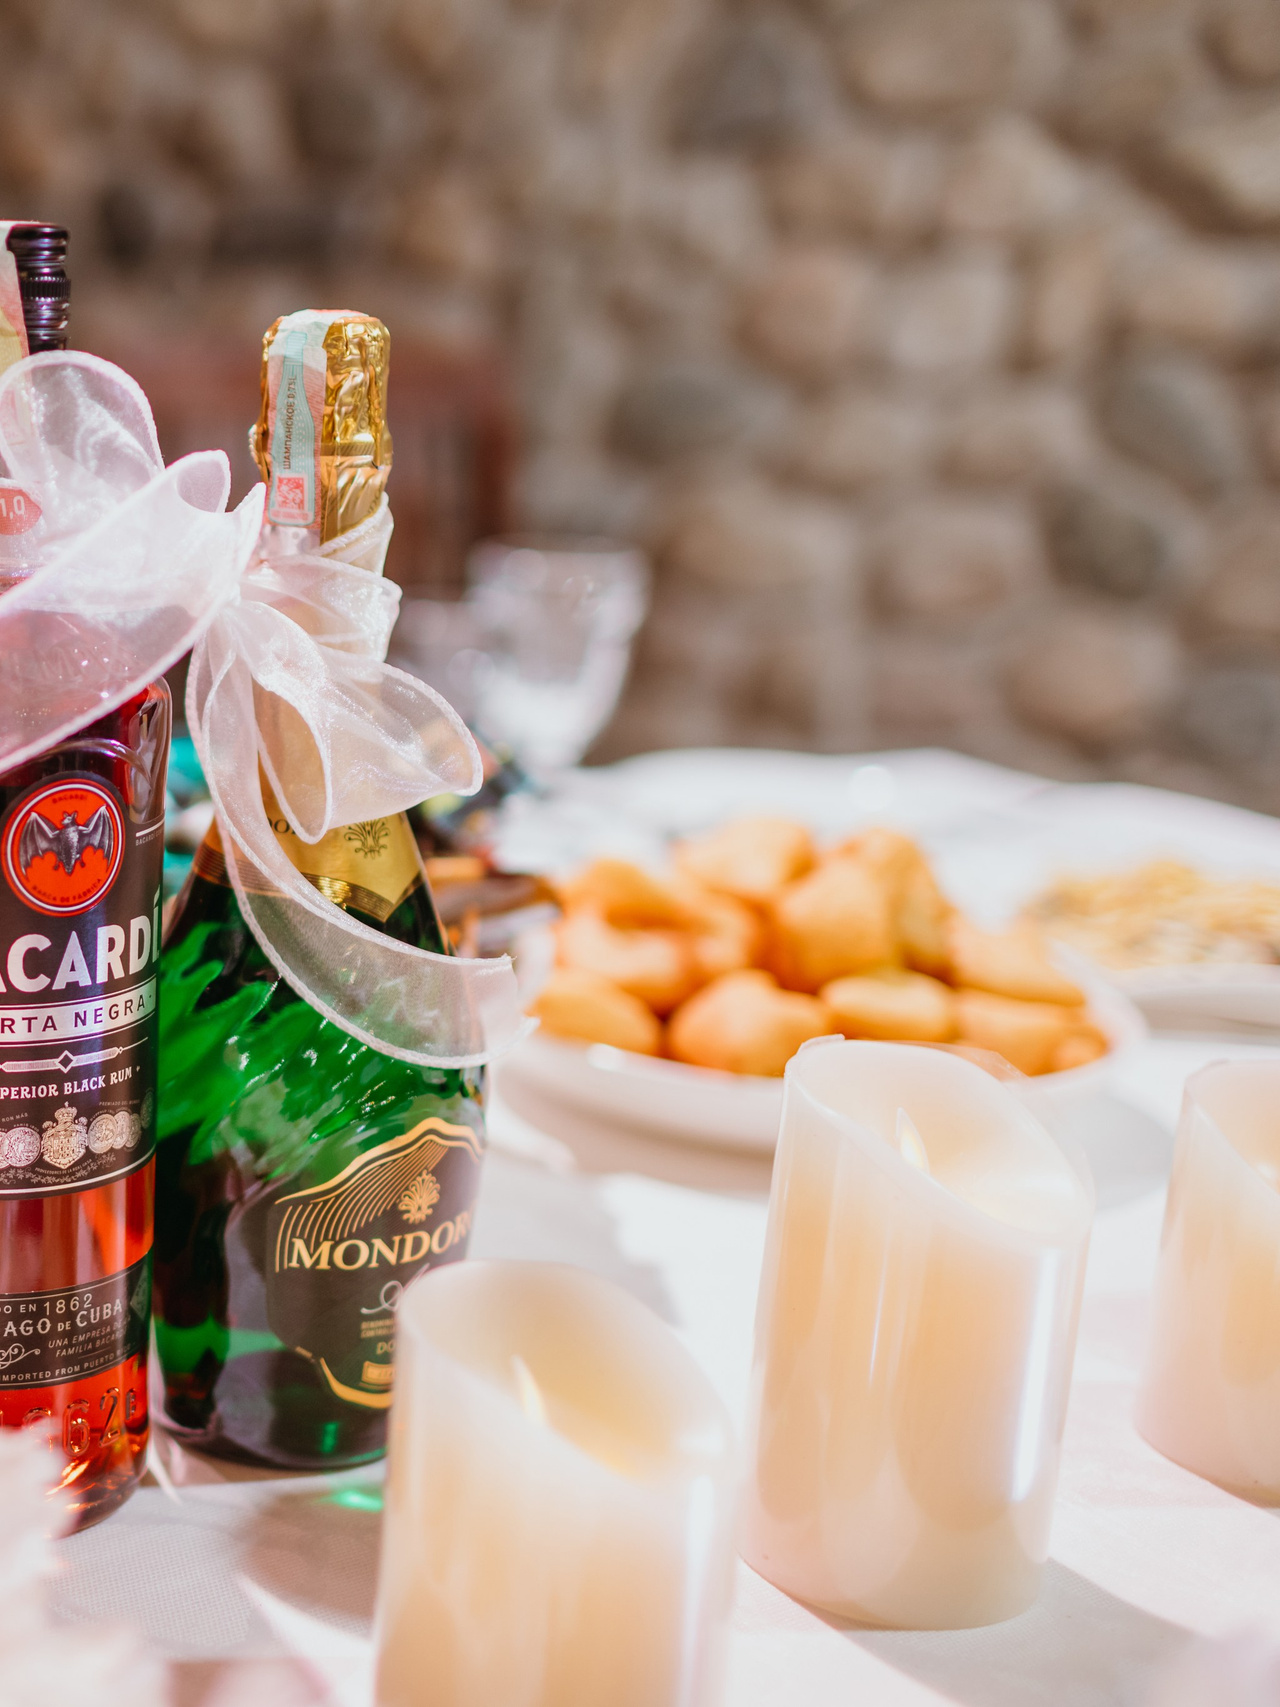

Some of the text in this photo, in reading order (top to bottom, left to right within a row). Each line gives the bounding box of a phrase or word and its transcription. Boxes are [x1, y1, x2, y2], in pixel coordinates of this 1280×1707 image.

[283, 402, 295, 470] ШАМПАНСКОЕ
[73, 994, 146, 1028] NEGRA
[64, 1074, 106, 1095] BLACK
[110, 1066, 132, 1085] RUM
[288, 1211, 469, 1271] MONDOR
[20, 1303, 36, 1313] EN
[43, 1293, 93, 1316] 1862
[57, 1321, 72, 1332] DE
[76, 1299, 122, 1327] CUBA
[48, 1338, 69, 1349] UNA
[72, 1325, 111, 1343] EMPRESA
[56, 1341, 93, 1358] FAMILIA
[55, 1365, 81, 1377] FROM
[83, 1353, 115, 1369] PUERTO
